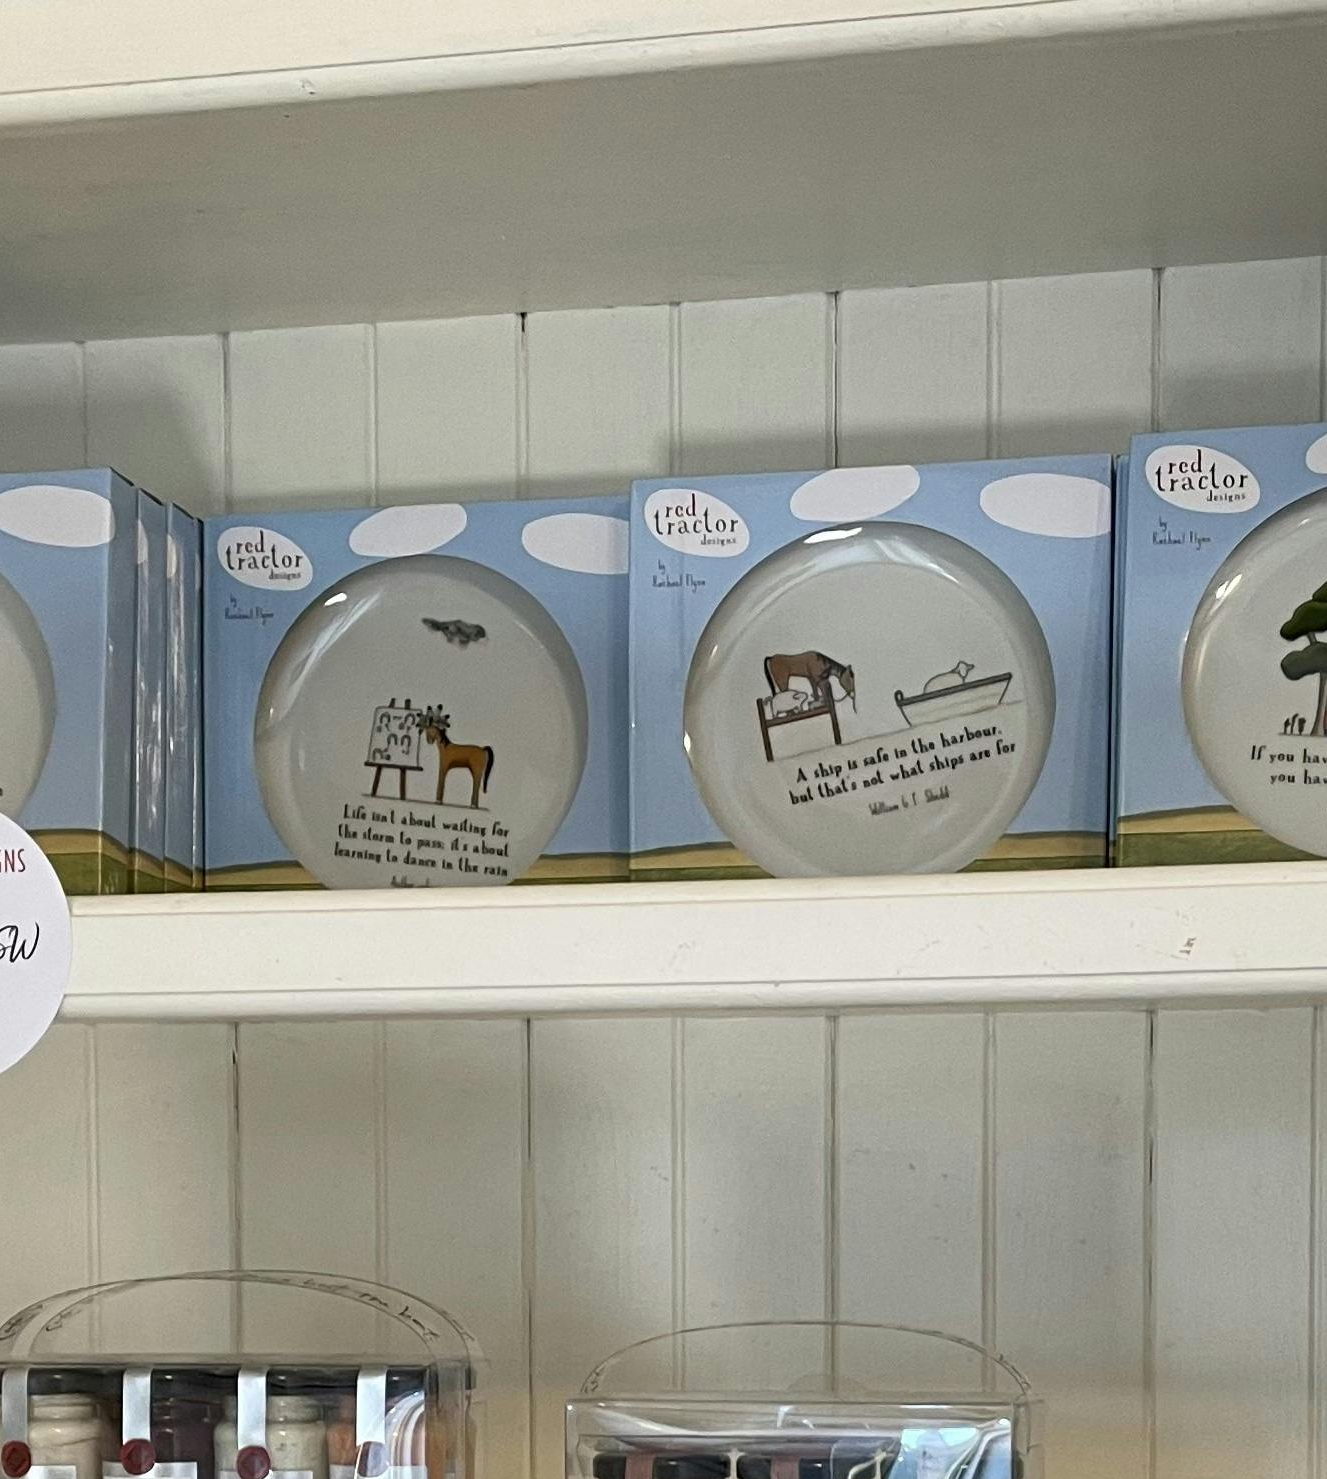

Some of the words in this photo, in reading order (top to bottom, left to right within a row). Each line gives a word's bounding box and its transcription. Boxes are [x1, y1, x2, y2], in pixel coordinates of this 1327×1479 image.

[1169, 449, 1202, 474] red
[1156, 462, 1248, 491] tractor
[665, 493, 696, 517] red
[1207, 490, 1245, 502] designs
[655, 507, 738, 535] tractor
[235, 530, 265, 554] red
[225, 544, 303, 570] tractor
[796, 768, 807, 783] A
[814, 763, 842, 778] ship
[848, 760, 858, 770] is
[863, 748, 889, 766] safe
[895, 747, 907, 758] in
[911, 738, 935, 755] the
[1251, 745, 1267, 761] If
[1269, 752, 1294, 763] you
[789, 787, 813, 805] but
[863, 770, 884, 788] not
[890, 761, 924, 781] what
[929, 753, 964, 771] ships
[970, 749, 990, 761] are
[996, 739, 1016, 755] for
[1270, 773, 1295, 785] you
